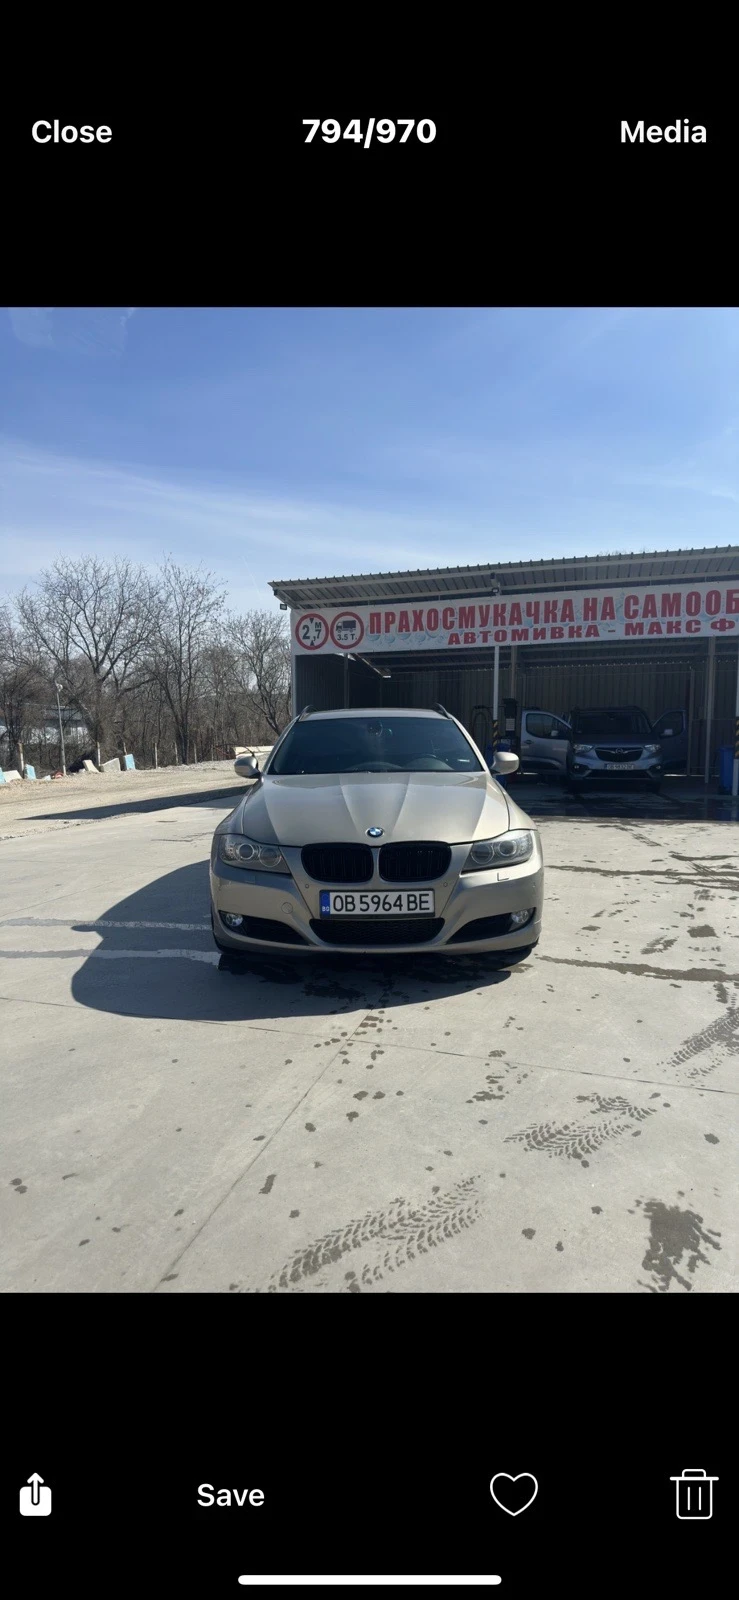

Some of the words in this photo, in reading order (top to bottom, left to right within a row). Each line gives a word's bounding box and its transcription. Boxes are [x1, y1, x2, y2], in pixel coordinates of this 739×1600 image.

[369, 599, 574, 634] ПРАХОСМУКАЧКА
[583, 597, 616, 621] НА
[624, 589, 739, 619] САМООБ
[448, 624, 600, 645] АВТОМИВКА
[624, 620, 701, 636] МАКС
[711, 618, 735, 632] Ф
[360, 894, 403, 912] 5964
